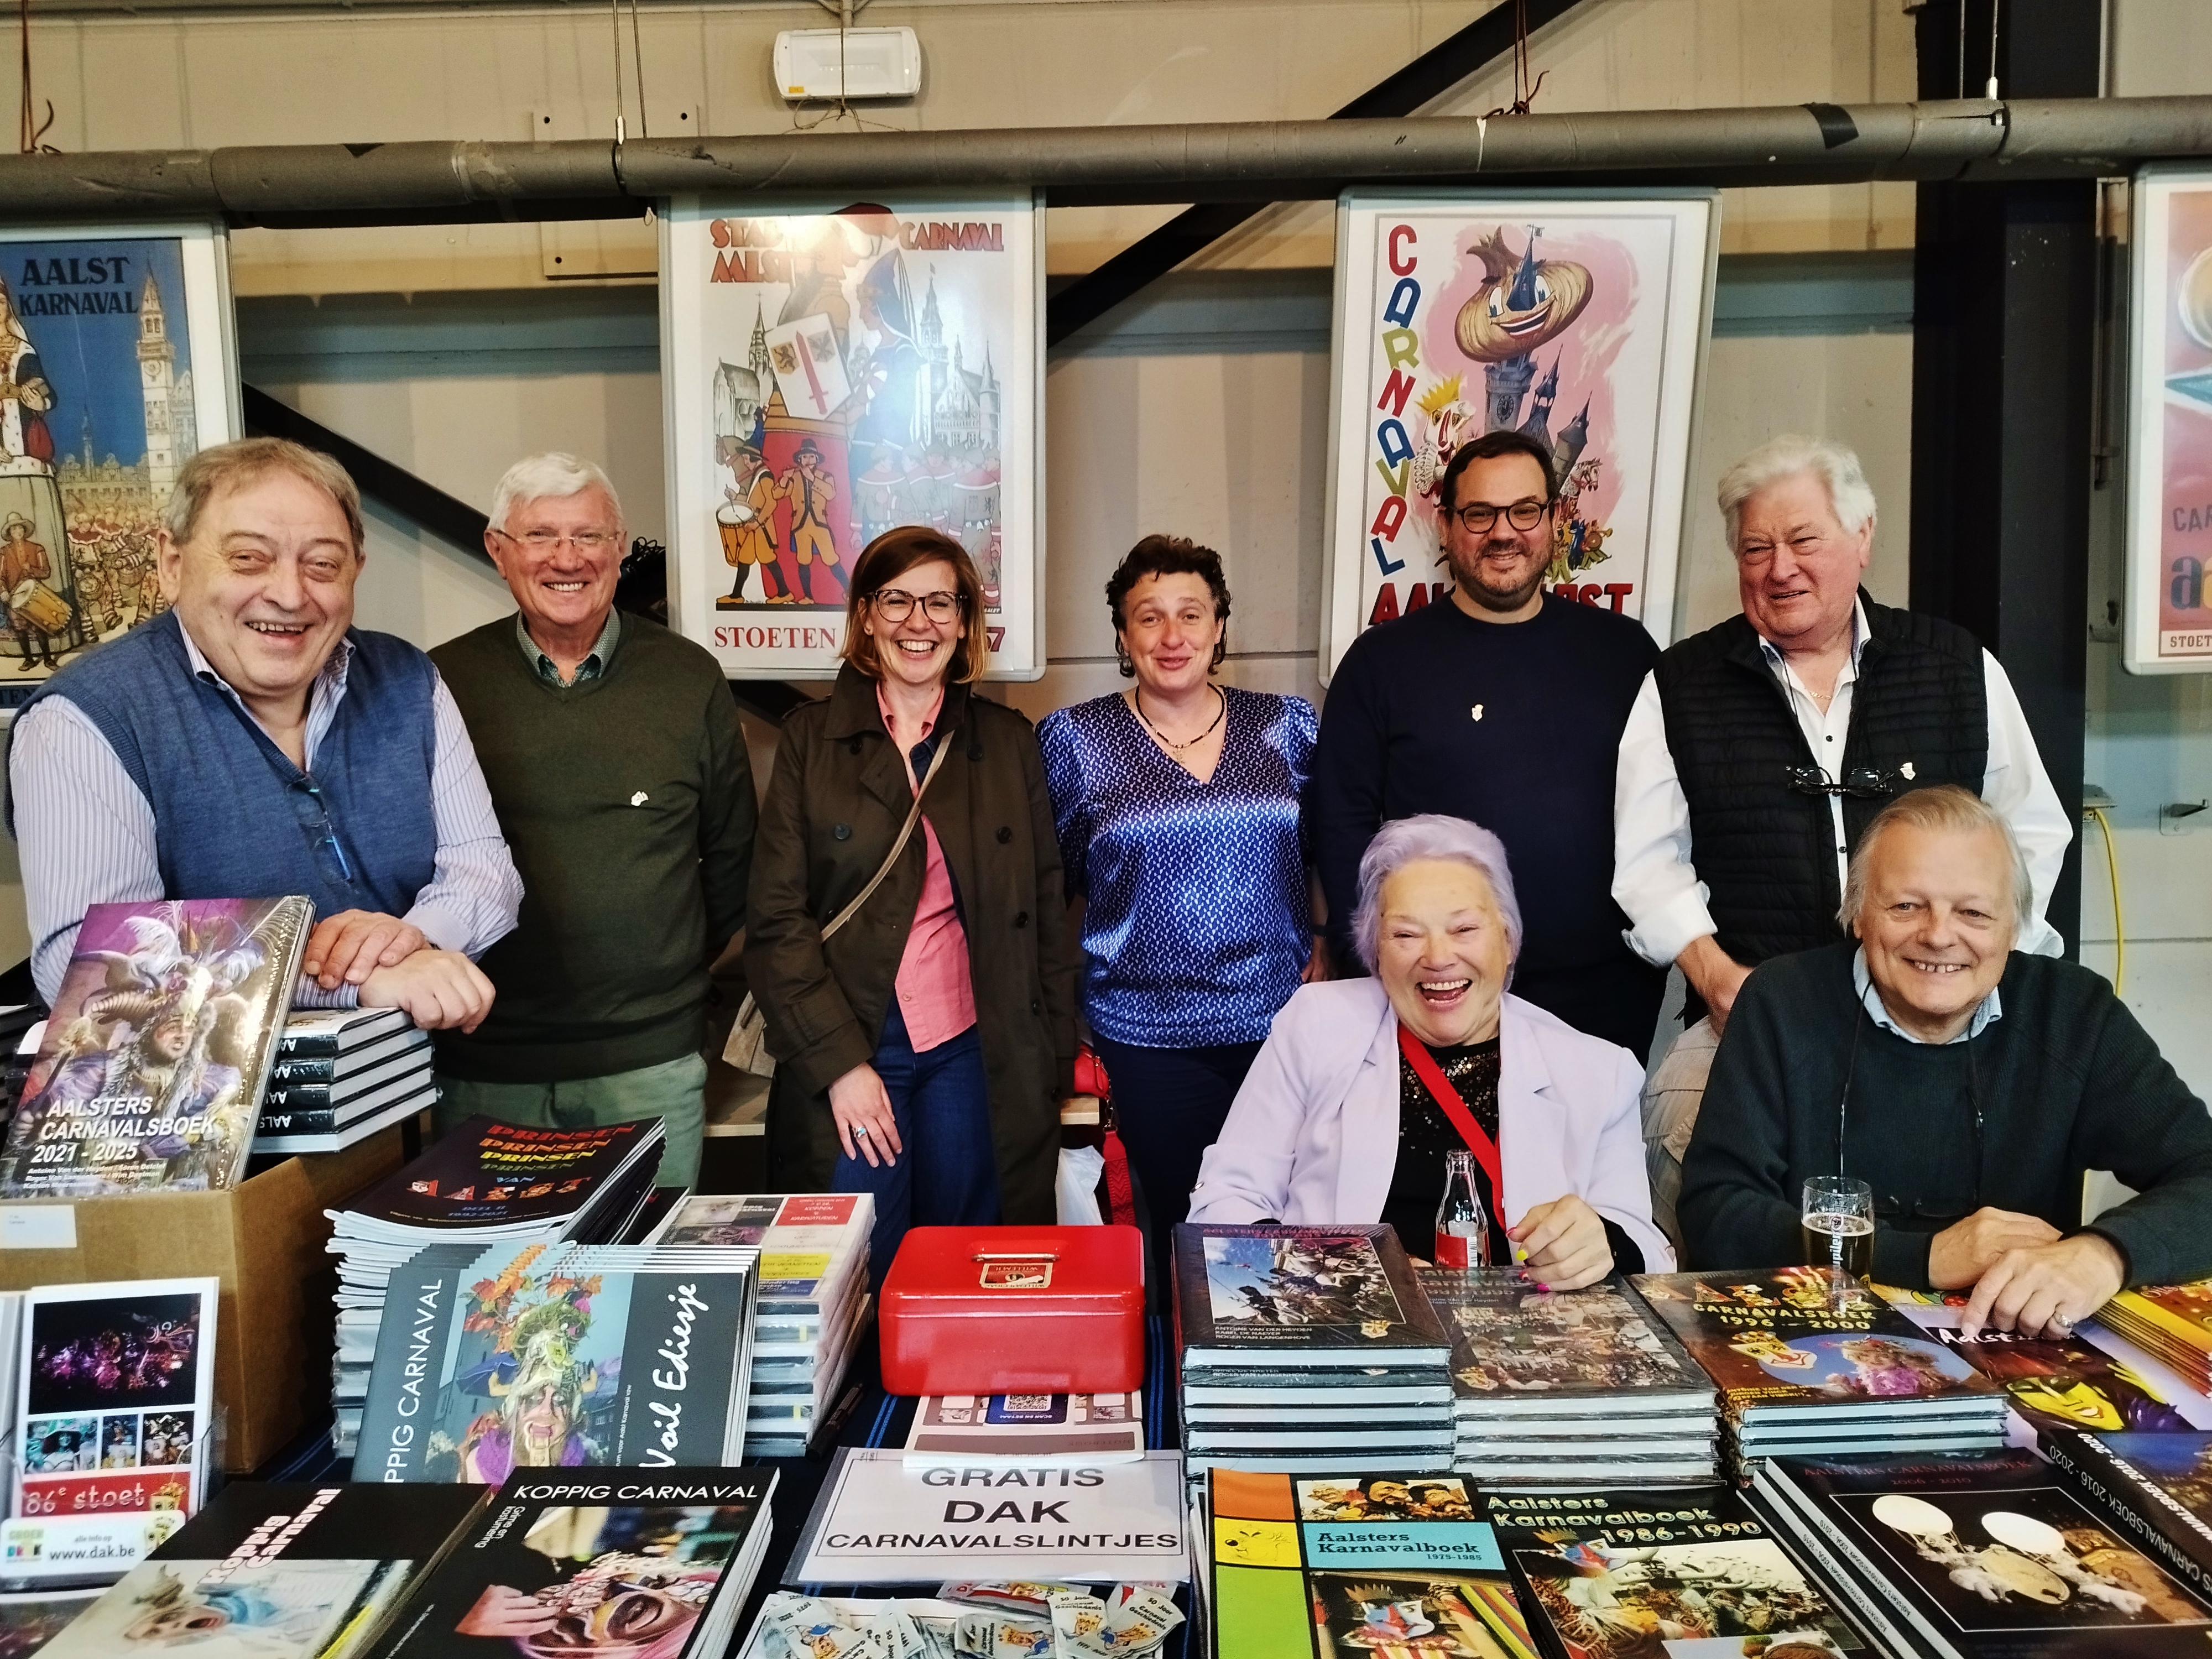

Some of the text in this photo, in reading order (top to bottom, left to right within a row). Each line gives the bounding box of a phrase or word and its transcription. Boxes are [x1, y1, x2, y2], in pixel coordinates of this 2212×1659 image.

[899, 222, 1005, 252] CARNAVAL
[20, 257, 130, 286] AALST
[19, 291, 139, 316] KARNAVAL
[1369, 224, 1422, 577] CARNAVAL
[714, 627, 837, 650] STOETEN
[46, 1096, 154, 1118] AALSTERS
[40, 1116, 216, 1140] CARNAVALSBOEK
[487, 1124, 637, 1141] PRINSEN
[30, 1142, 81, 1163] 2021
[92, 1141, 140, 1161] 2025
[479, 1138, 612, 1152] PRINSEN
[480, 1150, 597, 1162] PRINSEN
[480, 1162, 575, 1171] PRINSEN
[1693, 1303, 1877, 1321] CARNAVALSBOEK
[1720, 1316, 1774, 1328] 1996
[1808, 1320, 1871, 1329] 2000
[399, 1279, 442, 1417] CARNAVAL
[2049, 1445, 2074, 1475] 2020
[921, 1468, 1104, 1488] GRATIS
[2081, 1471, 2106, 1502] 2016
[74, 1482, 145, 1510] stoet
[513, 1485, 759, 1500] KOPPIG CARNAVAL
[1488, 1496, 1609, 1510] Aalsters
[492, 1506, 526, 1539] Grime en
[942, 1500, 1071, 1524] DAK
[1494, 1508, 1717, 1527] Karnavalboek
[246, 1489, 342, 1568] Carnaval
[474, 1506, 517, 1548] kostumering
[1317, 1532, 1410, 1543] Aalsters
[1600, 1522, 1762, 1544] 1986-1990
[2109, 1494, 2200, 1581] CARNAVALSBOEK
[197, 1515, 291, 1584] Koppig
[826, 1533, 1178, 1548] CARNAVALSLINTJES
[1318, 1542, 1479, 1554] Karnavalboek
[50, 1545, 135, 1560] www.dak.be
